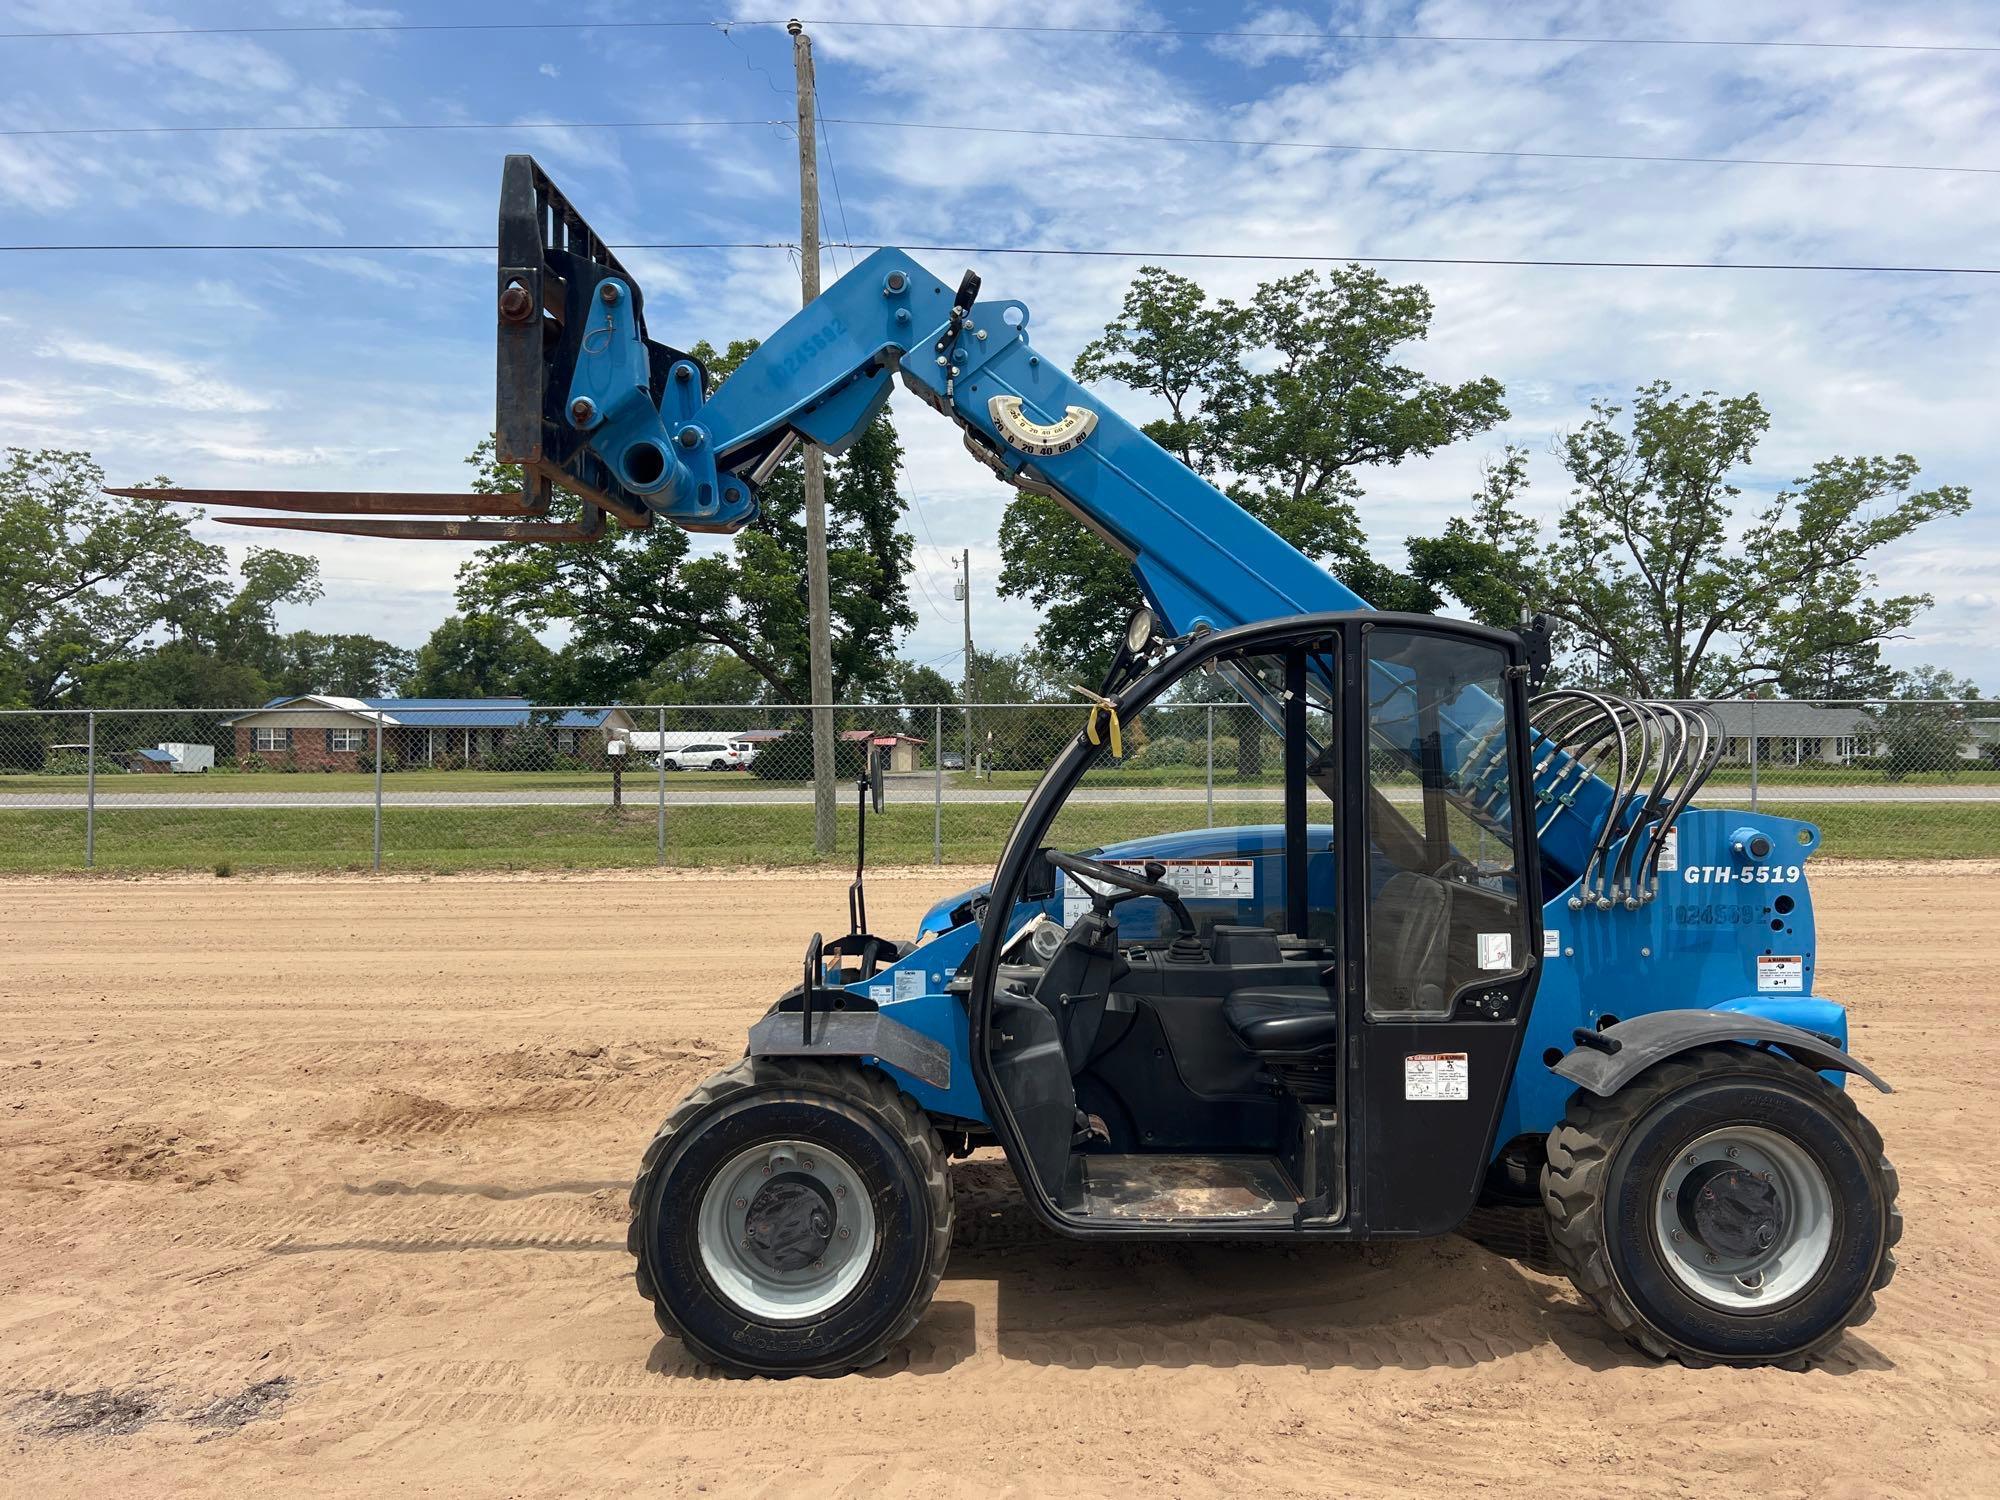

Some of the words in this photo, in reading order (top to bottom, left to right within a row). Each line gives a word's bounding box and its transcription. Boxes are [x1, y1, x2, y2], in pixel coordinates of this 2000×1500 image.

[1007, 435, 1015, 444] 0
[1021, 443, 1034, 454] 20
[1040, 447, 1053, 455] 40
[1058, 442, 1071, 453] 60
[1075, 431, 1087, 444] 80
[1684, 865, 1800, 884] GTH-5519
